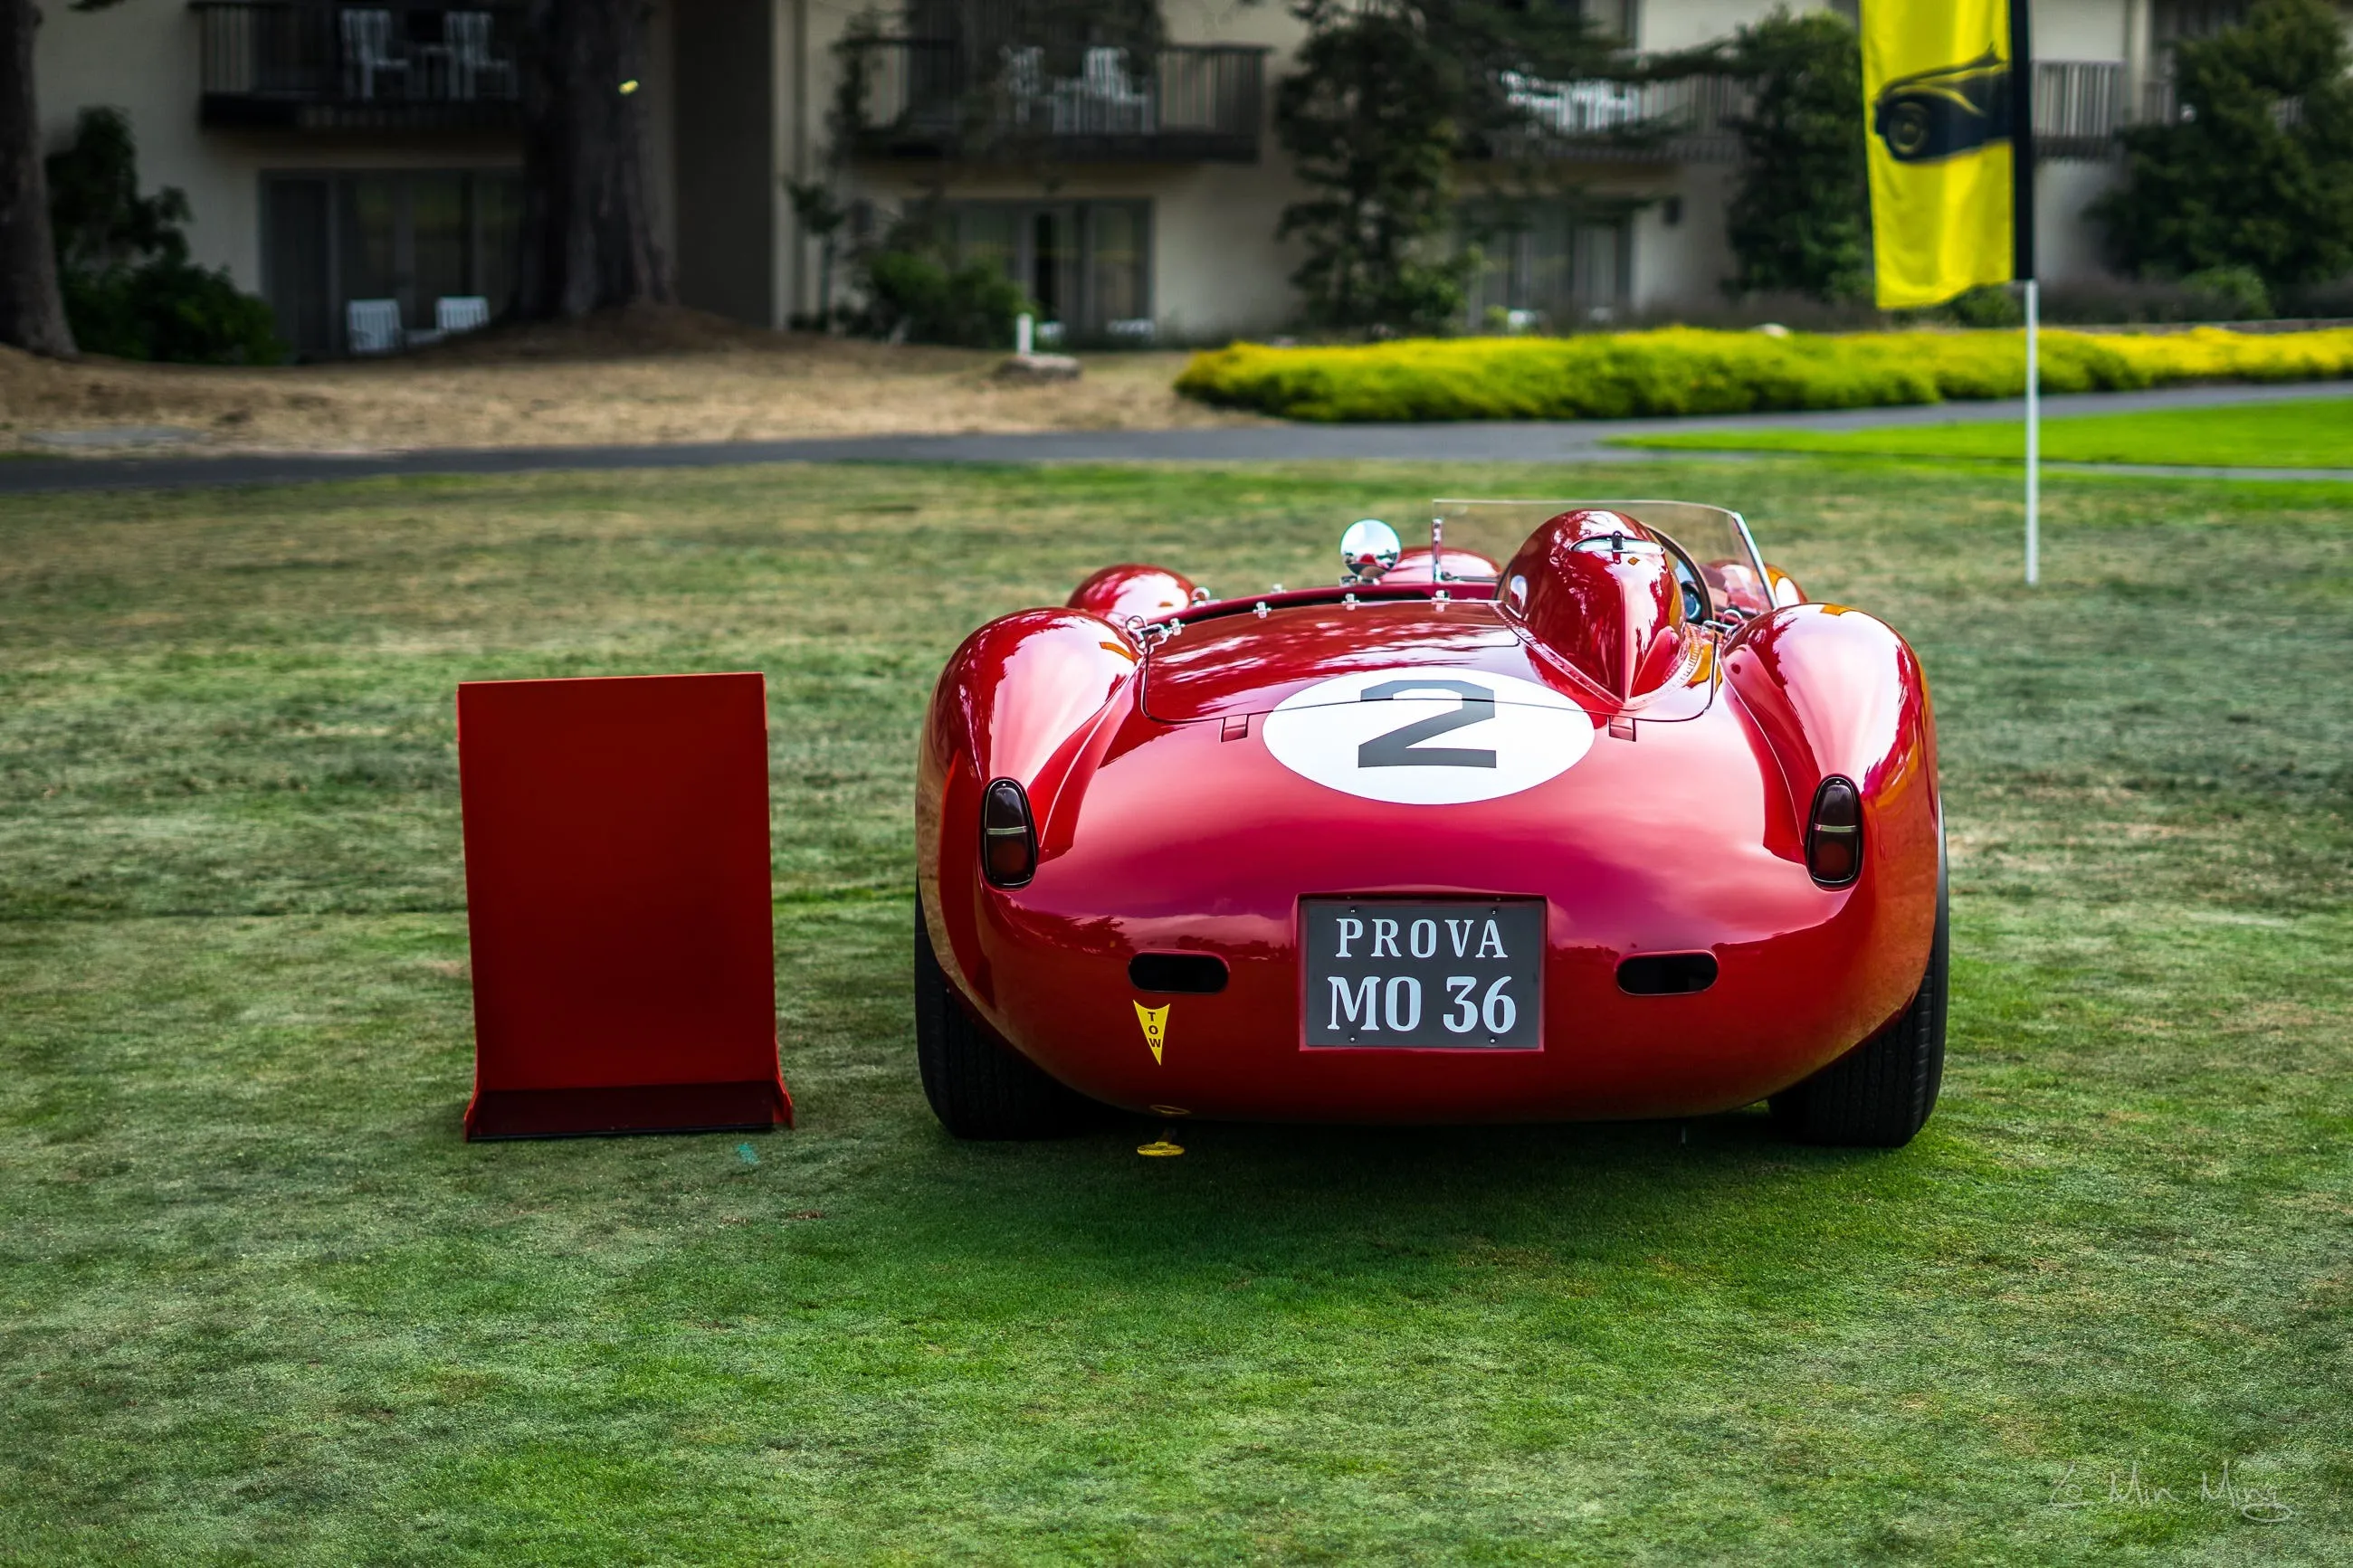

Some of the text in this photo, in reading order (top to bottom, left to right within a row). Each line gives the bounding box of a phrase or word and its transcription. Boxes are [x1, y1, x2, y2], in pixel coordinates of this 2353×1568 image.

[1358, 679, 1497, 768] 2
[1335, 917, 1509, 958] PROVA
[1327, 975, 1517, 1034] MO 36
[1148, 1012, 1161, 1048] TOW
